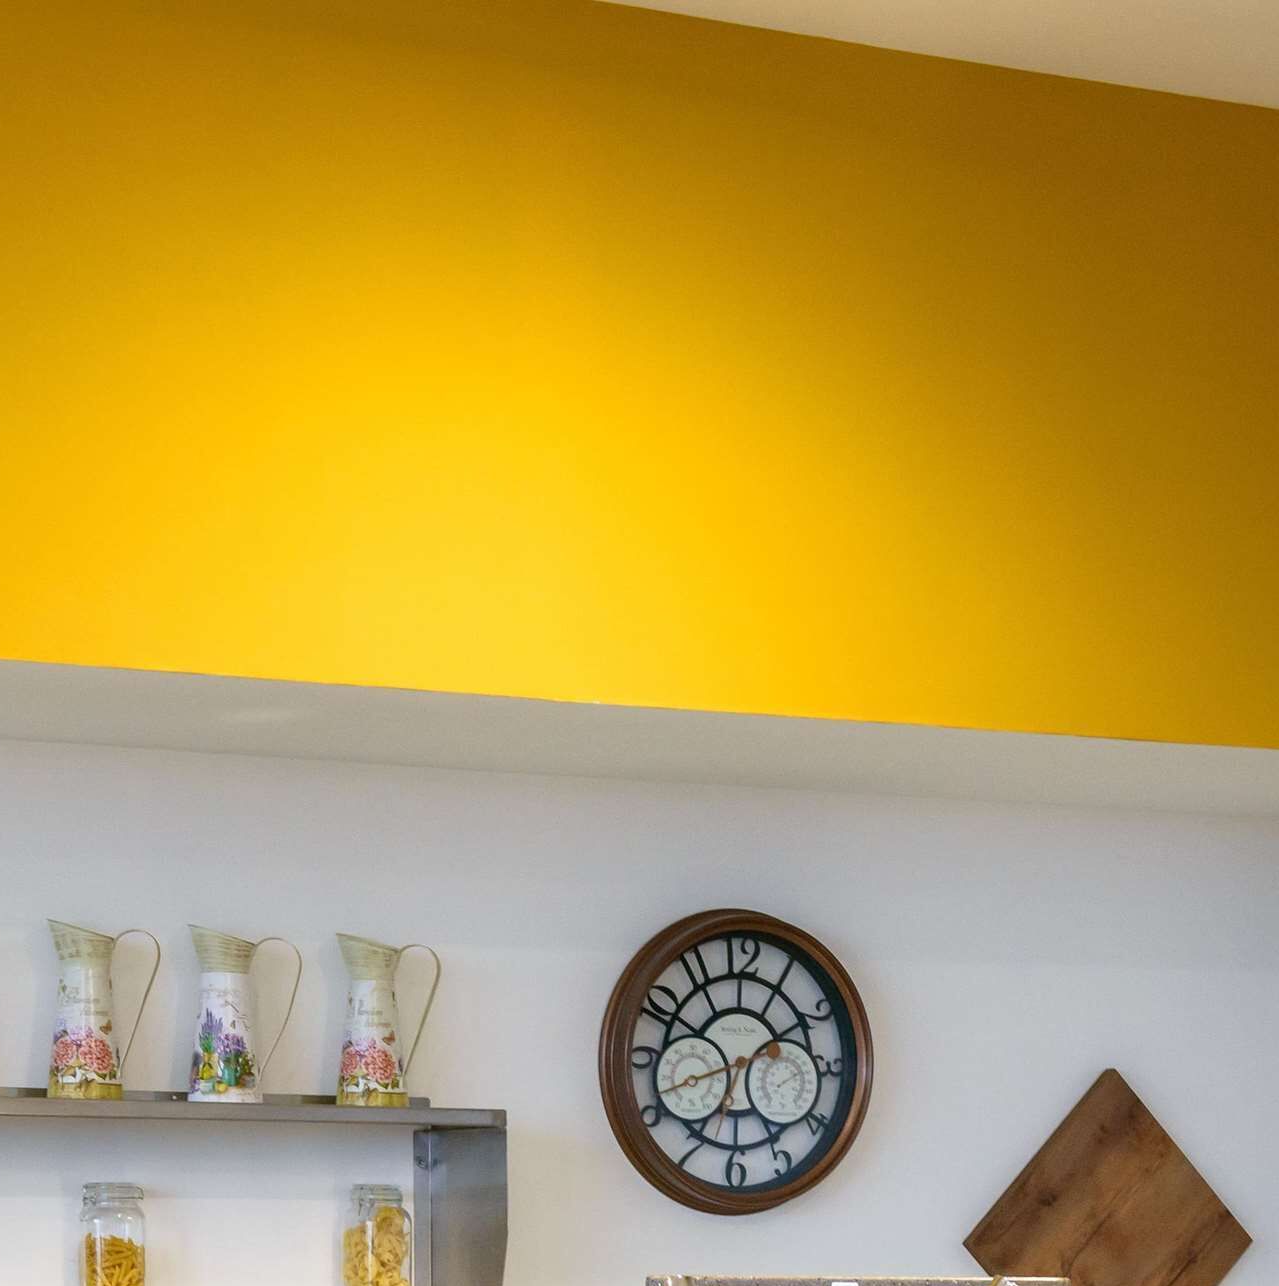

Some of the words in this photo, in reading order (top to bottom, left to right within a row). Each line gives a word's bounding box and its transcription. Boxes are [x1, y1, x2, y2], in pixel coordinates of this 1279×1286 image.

[680, 946, 710, 988] 11
[725, 936, 761, 975] 12
[640, 985, 679, 1027] 10
[799, 998, 832, 1029] 2
[631, 1045, 663, 1069] 9
[814, 1054, 843, 1077] 3
[806, 1111, 830, 1137] 4
[725, 1150, 748, 1188] 6
[770, 1134, 792, 1176] 5
